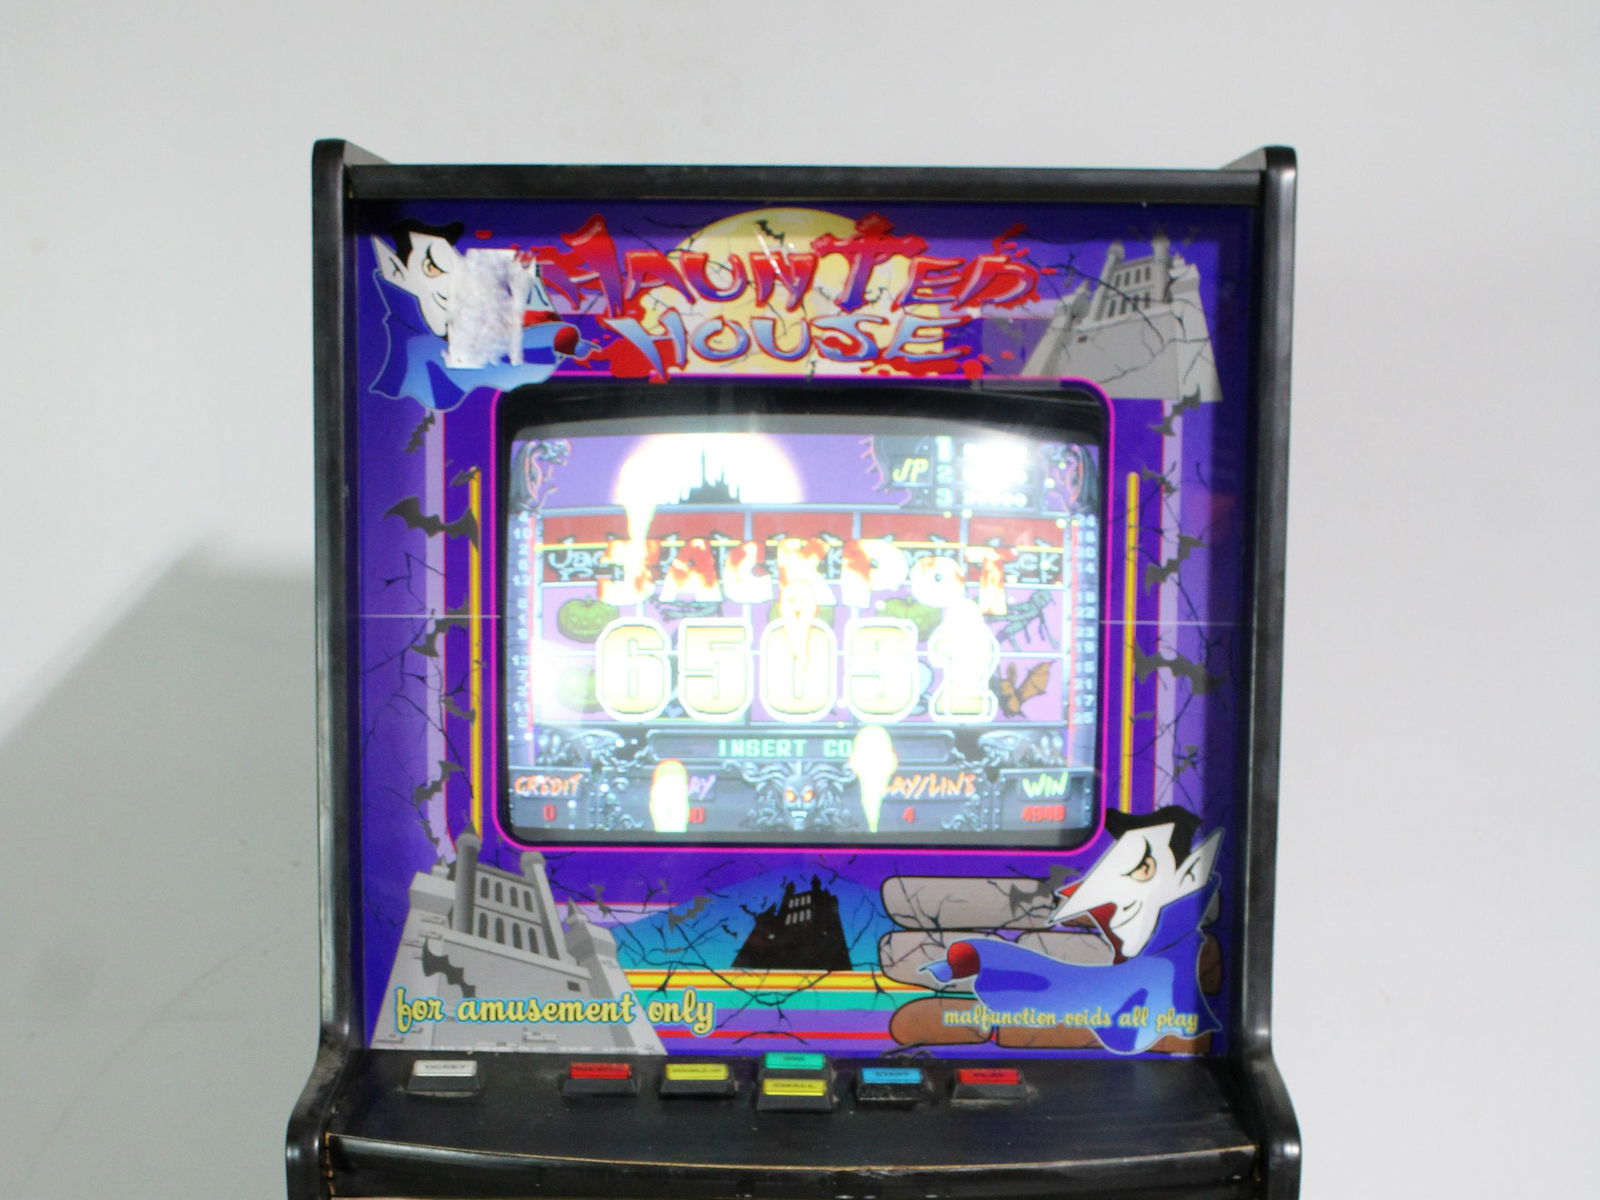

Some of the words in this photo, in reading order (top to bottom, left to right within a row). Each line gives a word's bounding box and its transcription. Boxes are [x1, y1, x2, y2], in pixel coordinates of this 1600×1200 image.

[540, 213, 1040, 316] HAUNTED
[605, 306, 972, 381] HOUSE
[892, 458, 930, 484] JP
[718, 739, 808, 758] INSERT
[822, 739, 853, 758] CO
[1022, 771, 1069, 797] WIN
[395, 986, 445, 1034] for
[456, 991, 636, 1025] amusement
[646, 985, 717, 1036] only
[943, 1004, 1058, 1033] malfunction
[1118, 1005, 1150, 1028] all
[1154, 1007, 1200, 1034] play
